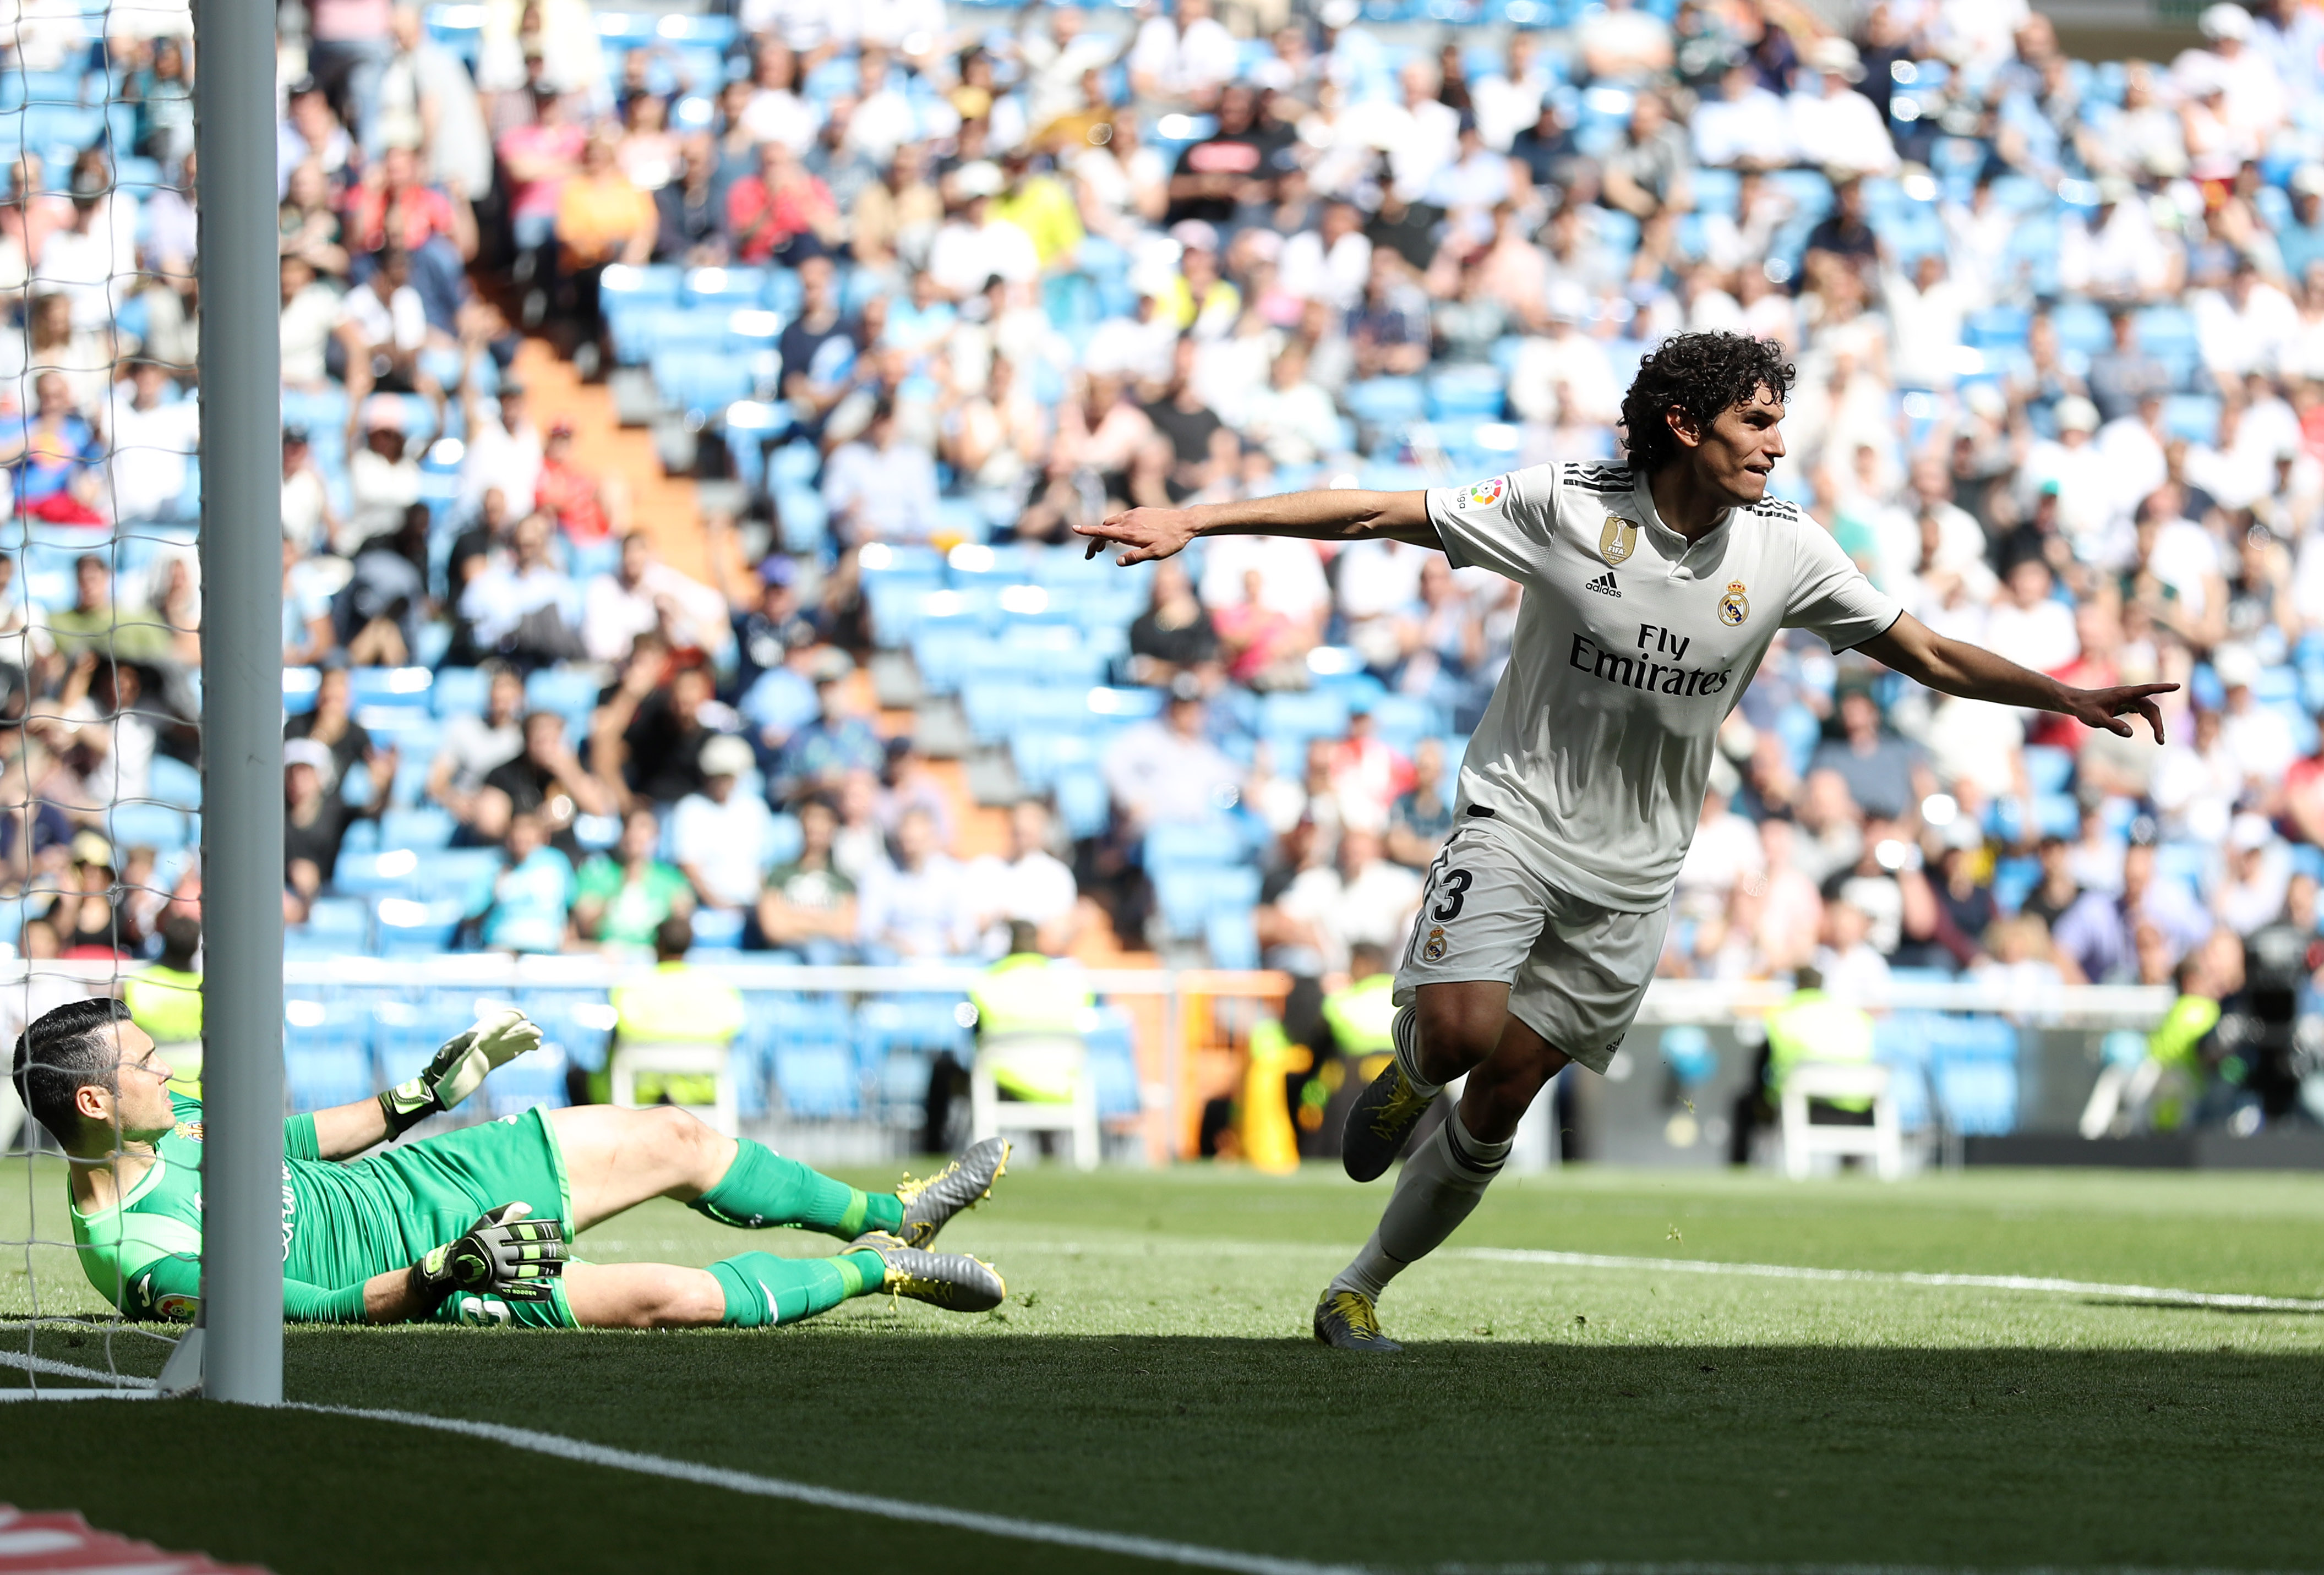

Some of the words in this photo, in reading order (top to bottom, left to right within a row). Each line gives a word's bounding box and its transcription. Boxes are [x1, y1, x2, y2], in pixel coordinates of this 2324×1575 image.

[1607, 546, 1624, 555] FIFA
[1585, 582, 1622, 598] adidas
[1638, 624, 1690, 660] Fly
[1570, 632, 1731, 697] Emirates
[1431, 869, 1472, 923] 3
